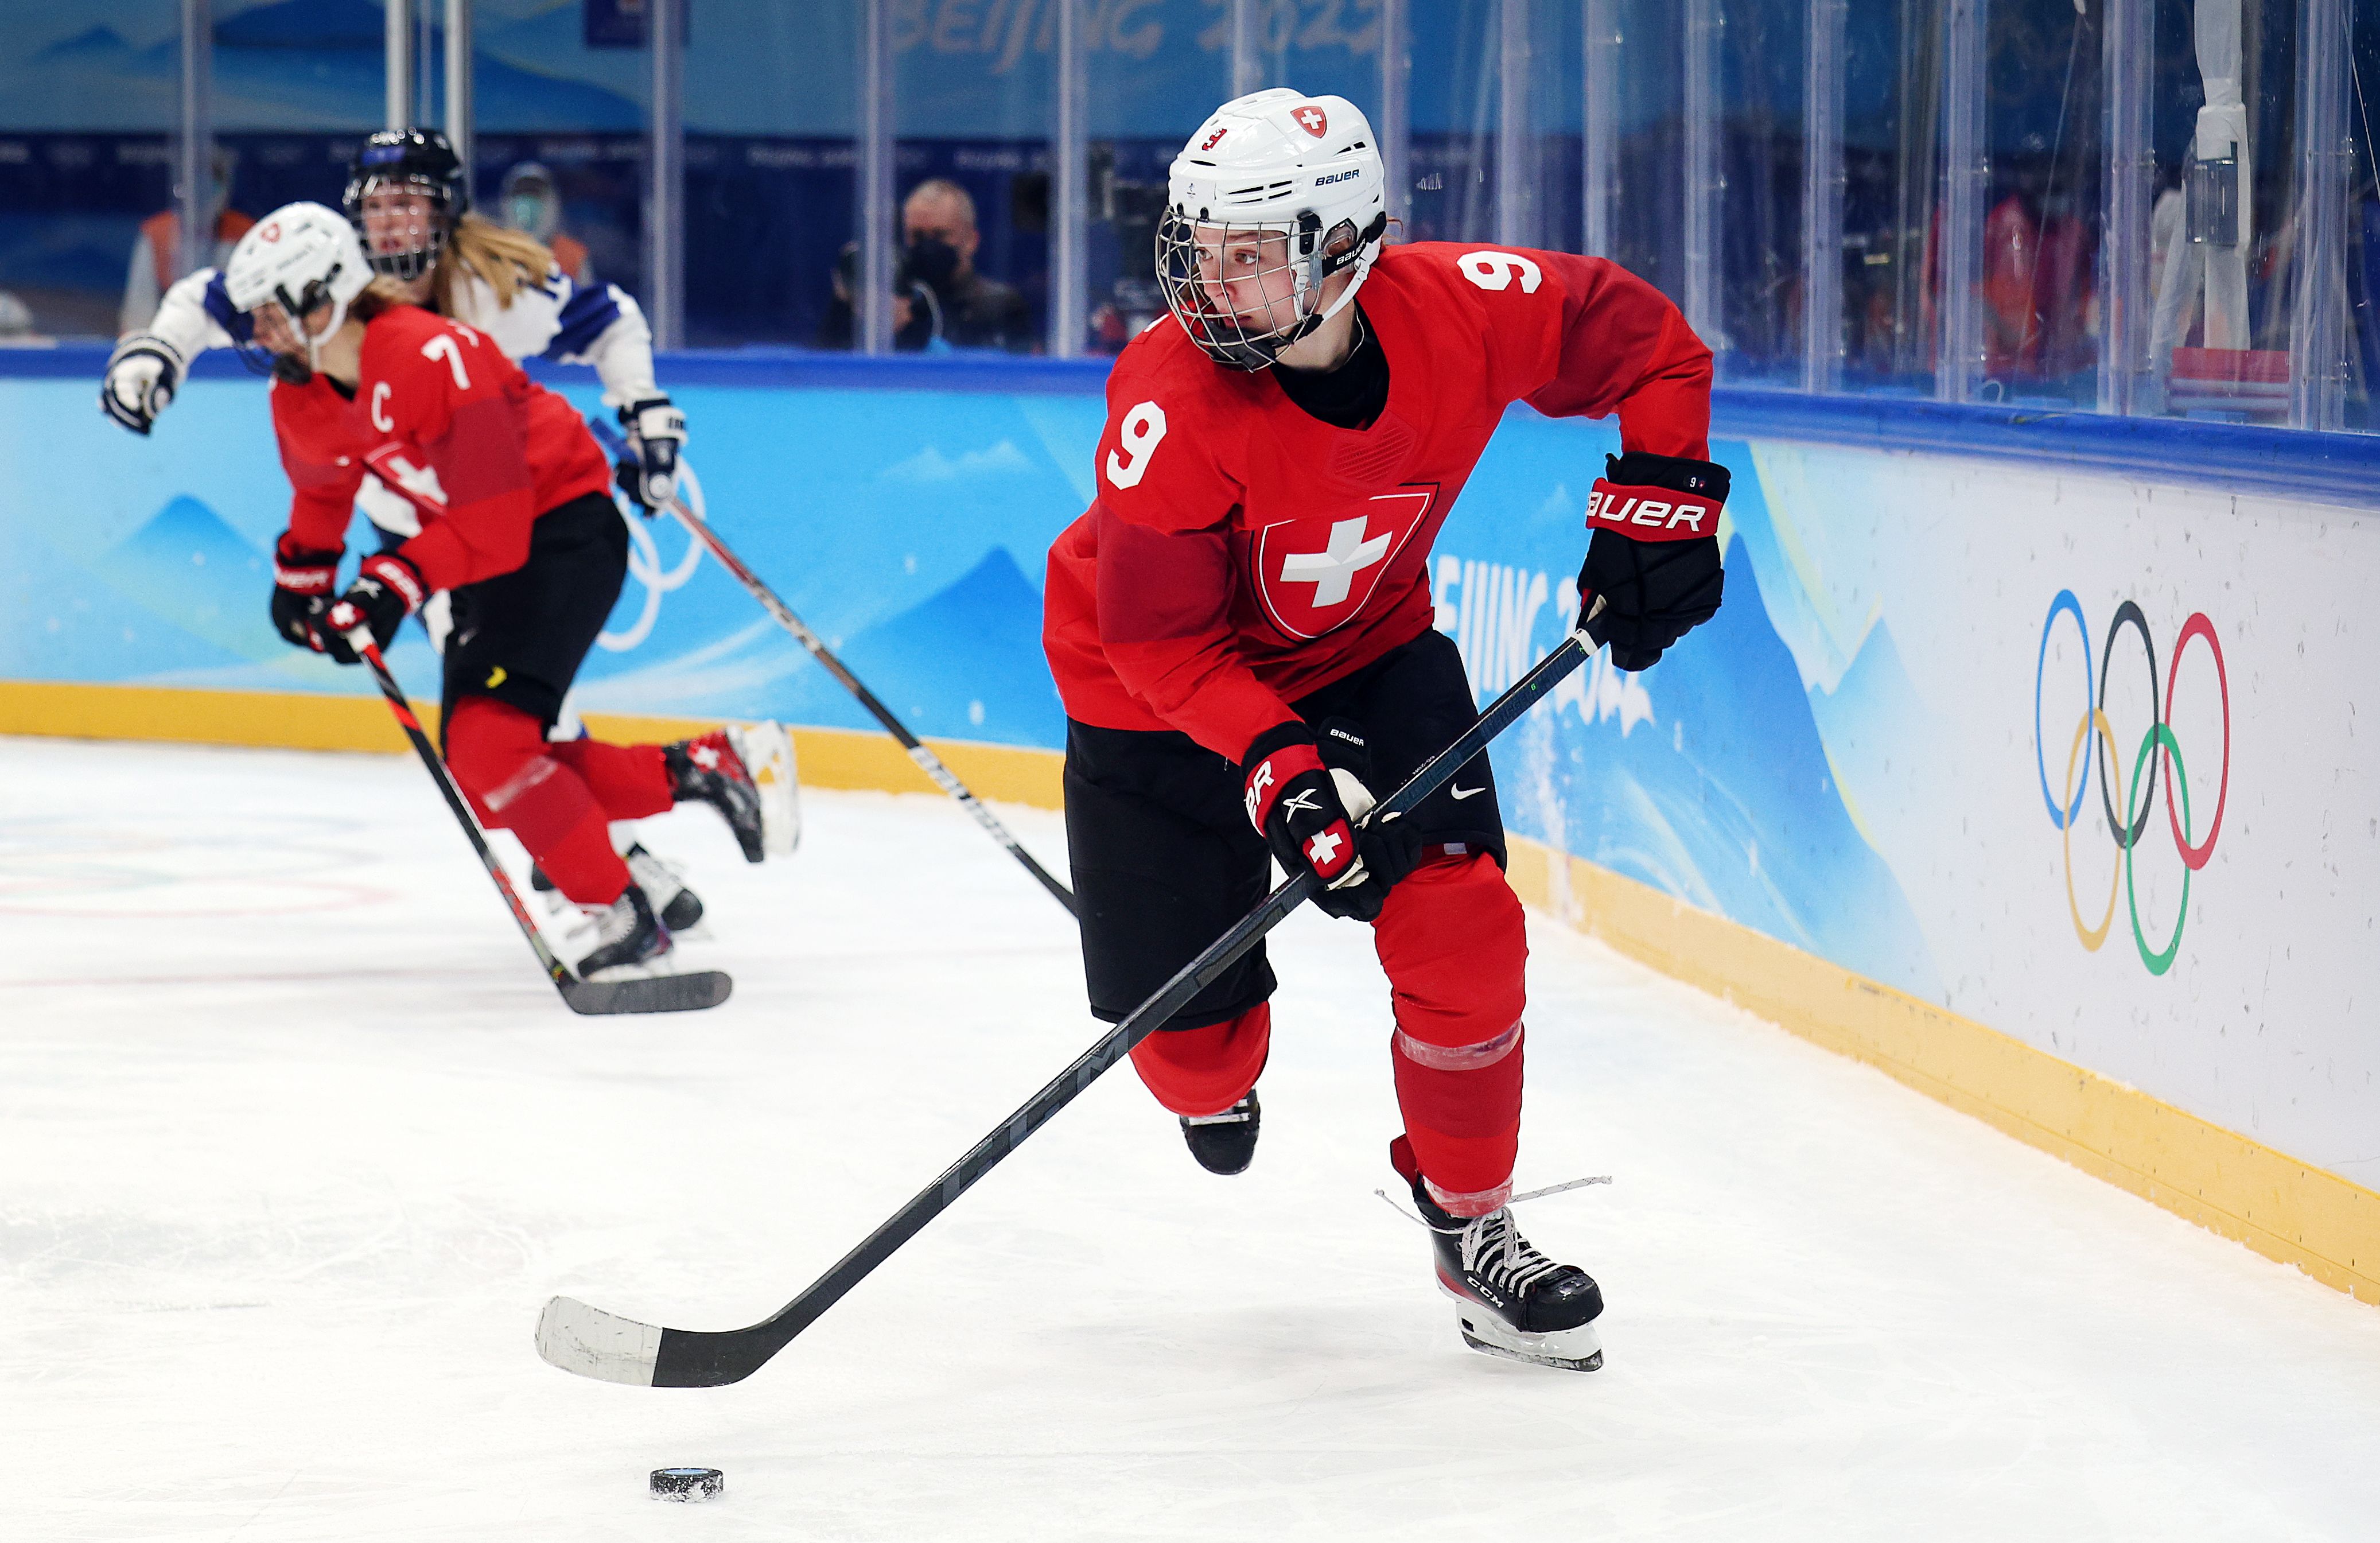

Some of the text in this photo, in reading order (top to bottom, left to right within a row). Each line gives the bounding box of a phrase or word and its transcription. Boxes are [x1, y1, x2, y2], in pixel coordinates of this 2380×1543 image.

[1456, 250, 1542, 294] 9
[420, 333, 470, 390] 7
[371, 380, 395, 433] C
[1106, 400, 1168, 491] 9
[1689, 477, 1697, 488] 9
[1586, 491, 1706, 532] AUER
[1467, 1275, 1504, 1308] CCM
